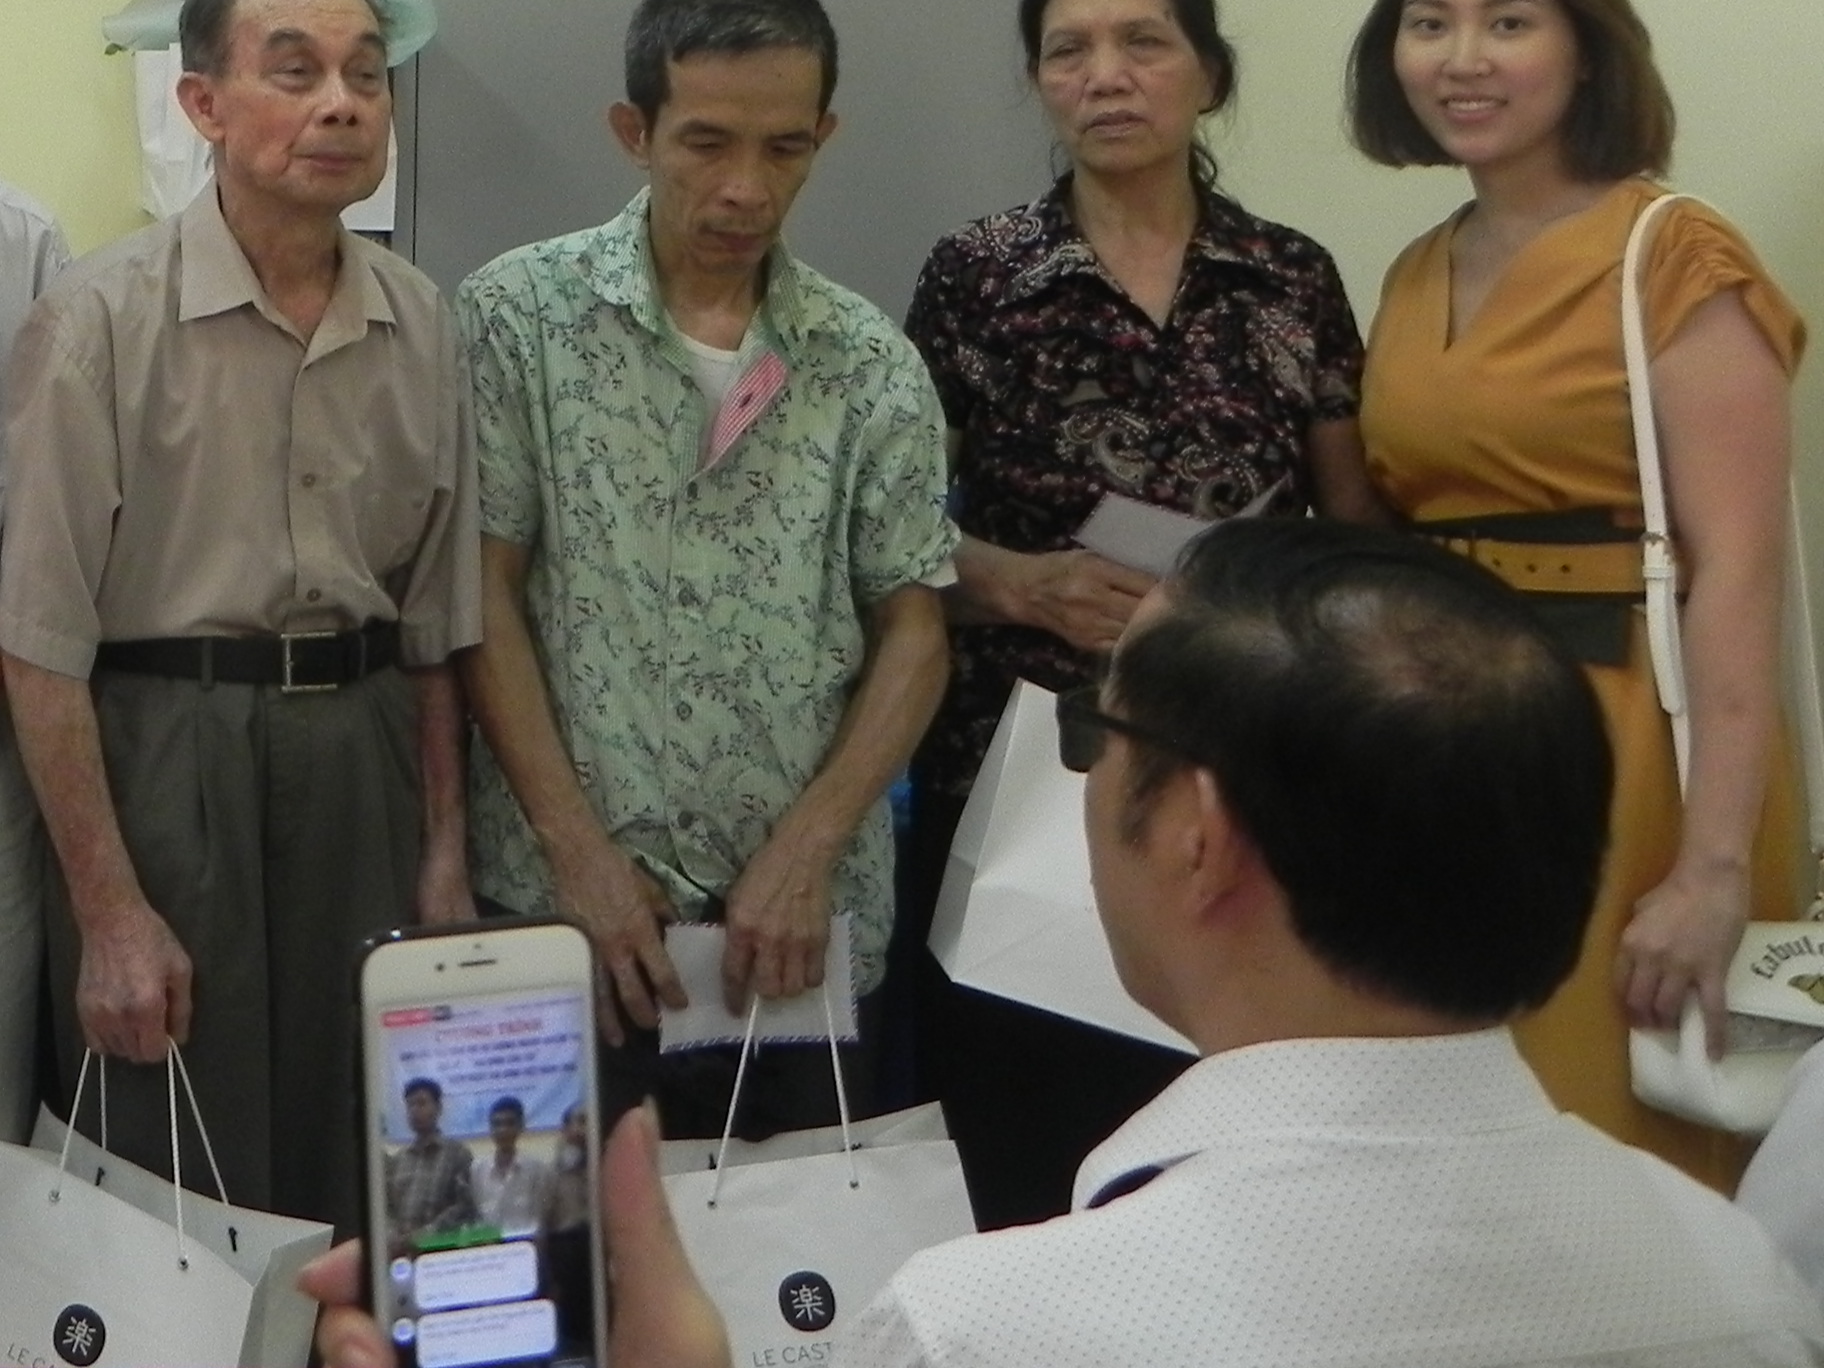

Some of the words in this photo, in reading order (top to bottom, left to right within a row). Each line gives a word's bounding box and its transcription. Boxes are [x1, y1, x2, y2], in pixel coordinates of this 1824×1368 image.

[7, 1342, 29, 1365] LE
[752, 1348, 776, 1367] LE
[782, 1341, 832, 1364] CAST
